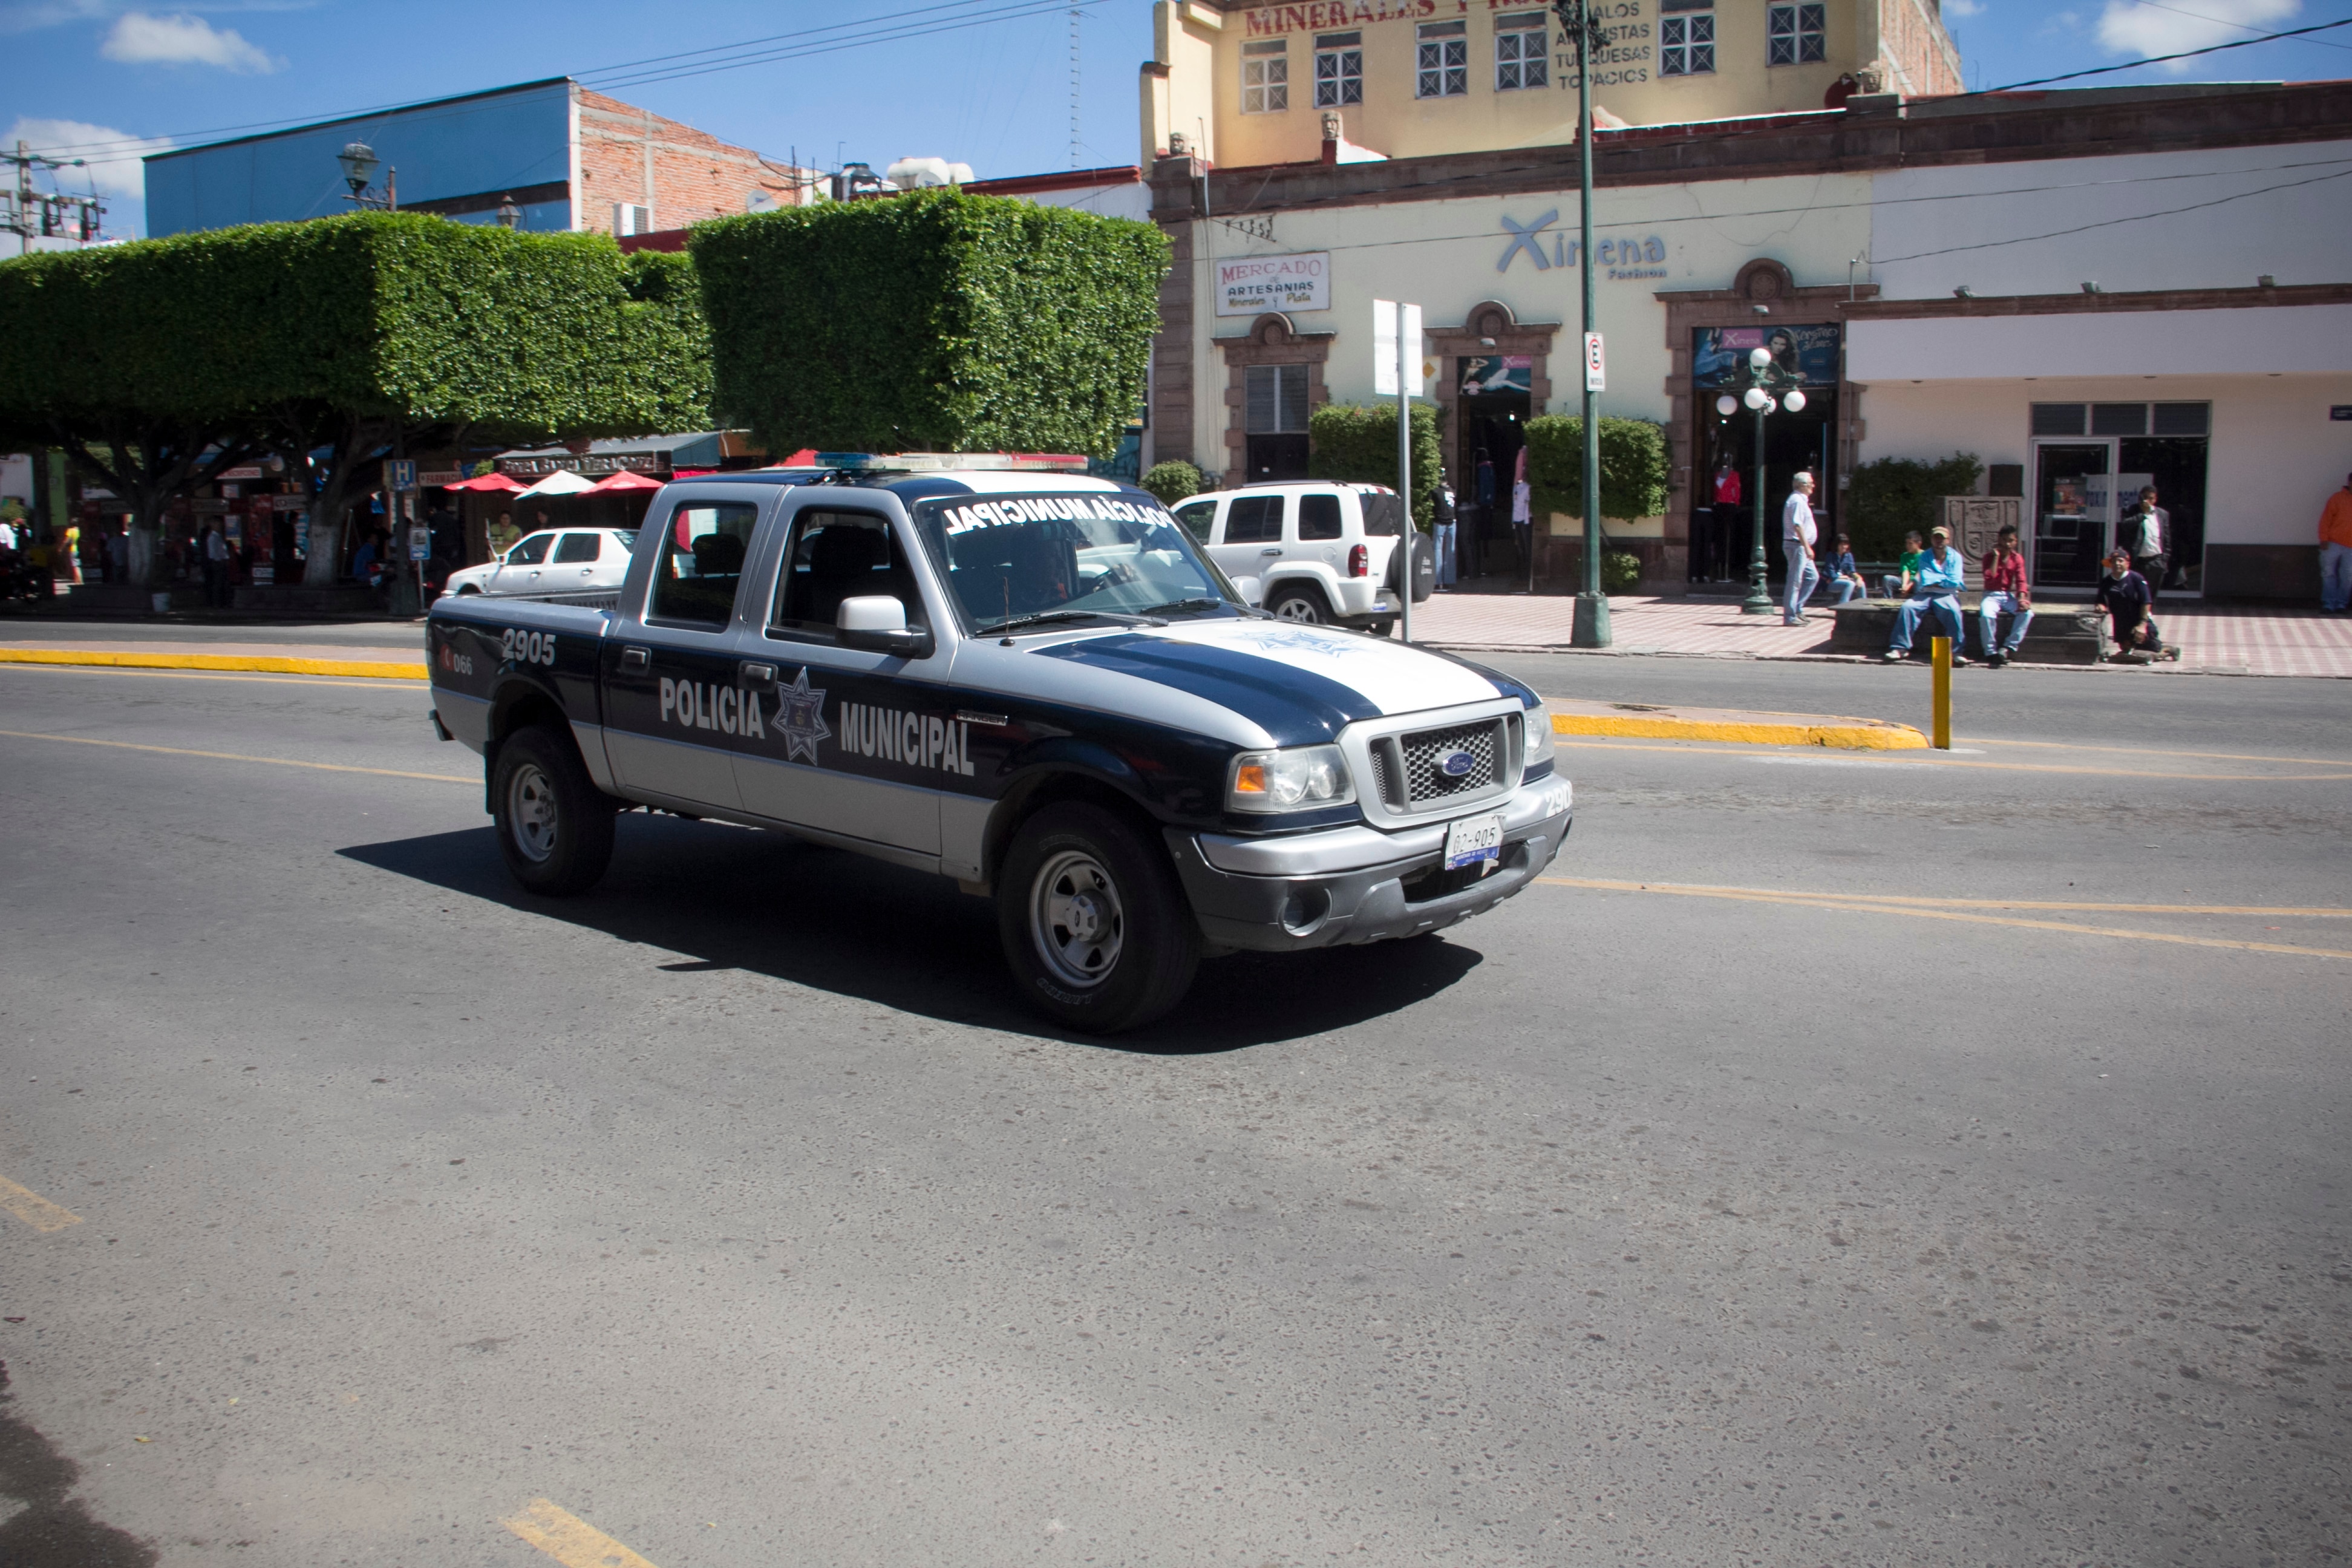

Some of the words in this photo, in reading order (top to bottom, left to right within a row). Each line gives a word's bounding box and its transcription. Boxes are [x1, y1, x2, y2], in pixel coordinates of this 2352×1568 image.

[1246, 0, 1435, 37] MINERALES
[1555, 24, 1650, 47] AISTAS
[1555, 46, 1651, 68] TUQUESAS
[1221, 260, 1322, 286] MERCADO
[1608, 267, 1667, 280] Fashion
[1227, 281, 1315, 296] ARTESANIAS
[1229, 297, 1266, 308] Minerales
[1287, 292, 1312, 304] Plata
[1725, 332, 1760, 346] Ximena
[396, 462, 410, 482] H
[426, 473, 462, 484] FARMACIA
[502, 628, 557, 666] 2905
[453, 653, 473, 676] 066
[660, 677, 765, 739] POLICIA
[840, 701, 975, 777] MUNICIPAL
[958, 711, 1005, 725] RANGER
[1036, 977, 1093, 1005] LAREDO
